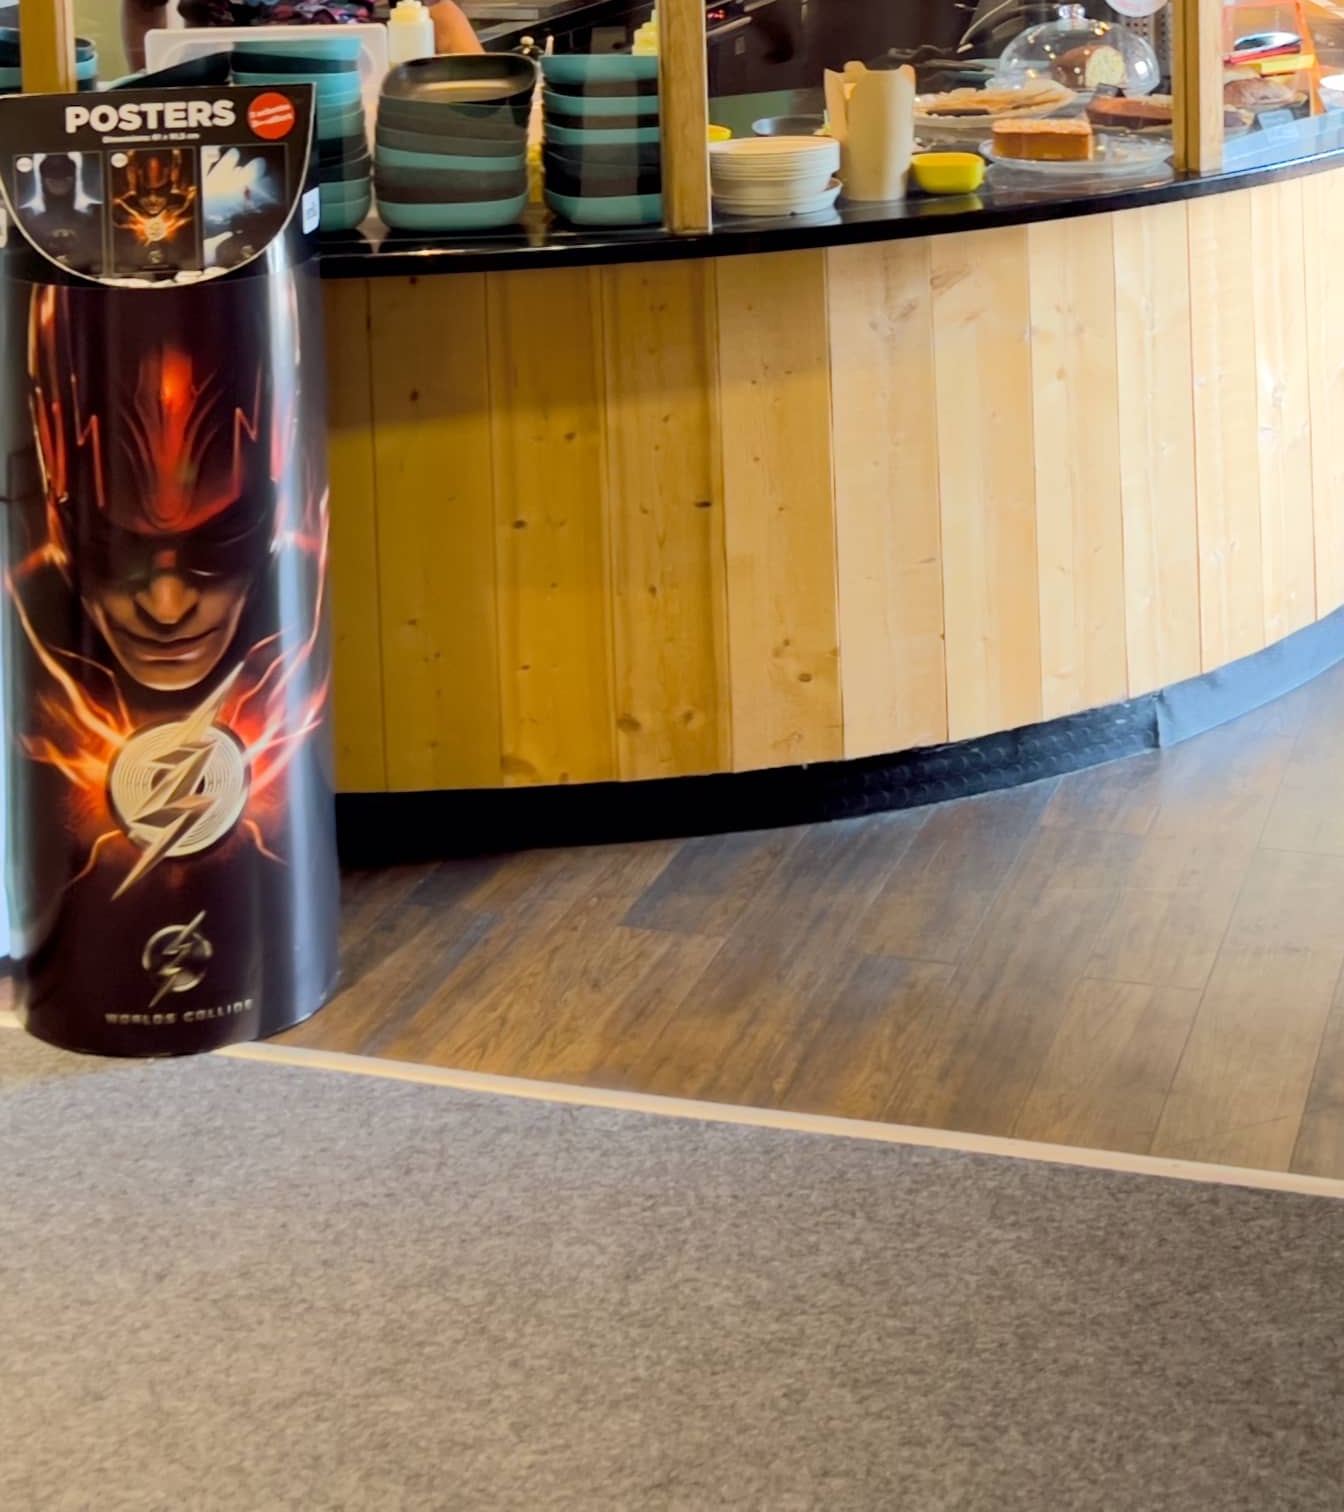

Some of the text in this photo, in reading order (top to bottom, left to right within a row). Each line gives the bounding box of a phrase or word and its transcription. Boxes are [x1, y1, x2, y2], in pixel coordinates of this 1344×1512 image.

[64, 99, 236, 134] POSTERS
[105, 998, 254, 1025] WORLDS COLLIDE
